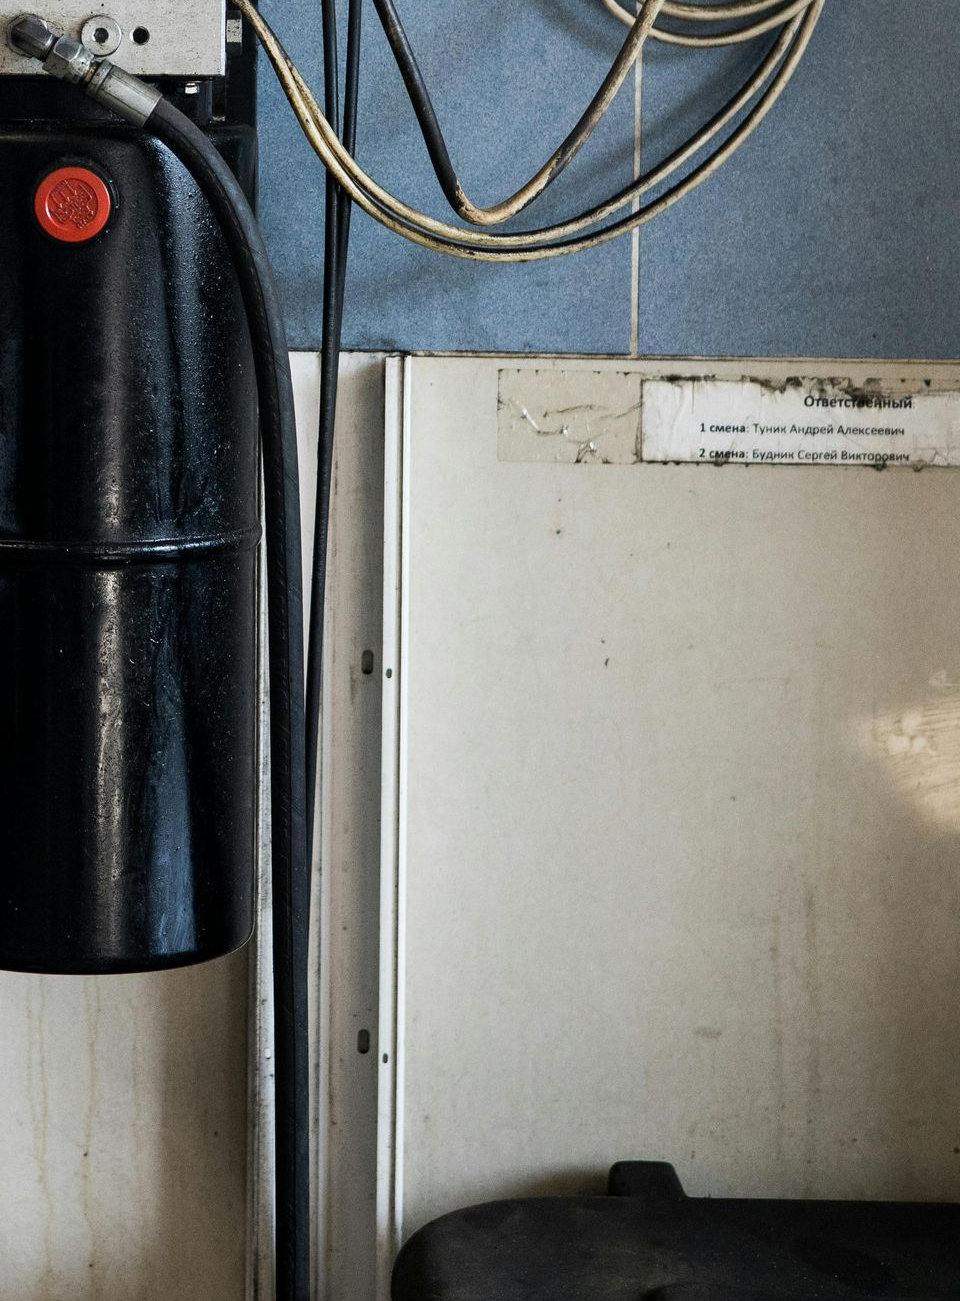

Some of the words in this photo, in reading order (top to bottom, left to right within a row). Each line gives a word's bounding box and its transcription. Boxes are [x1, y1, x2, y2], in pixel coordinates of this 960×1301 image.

[700, 423, 706, 433] 1
[709, 425, 749, 434] смена:
[752, 423, 787, 436] Туник
[789, 423, 834, 437] Андрей
[837, 424, 905, 436] Алексеевич
[699, 448, 706, 458] 2
[752, 449, 795, 462] Будник
[797, 449, 838, 462] Сергей
[841, 450, 910, 463] Викторович
